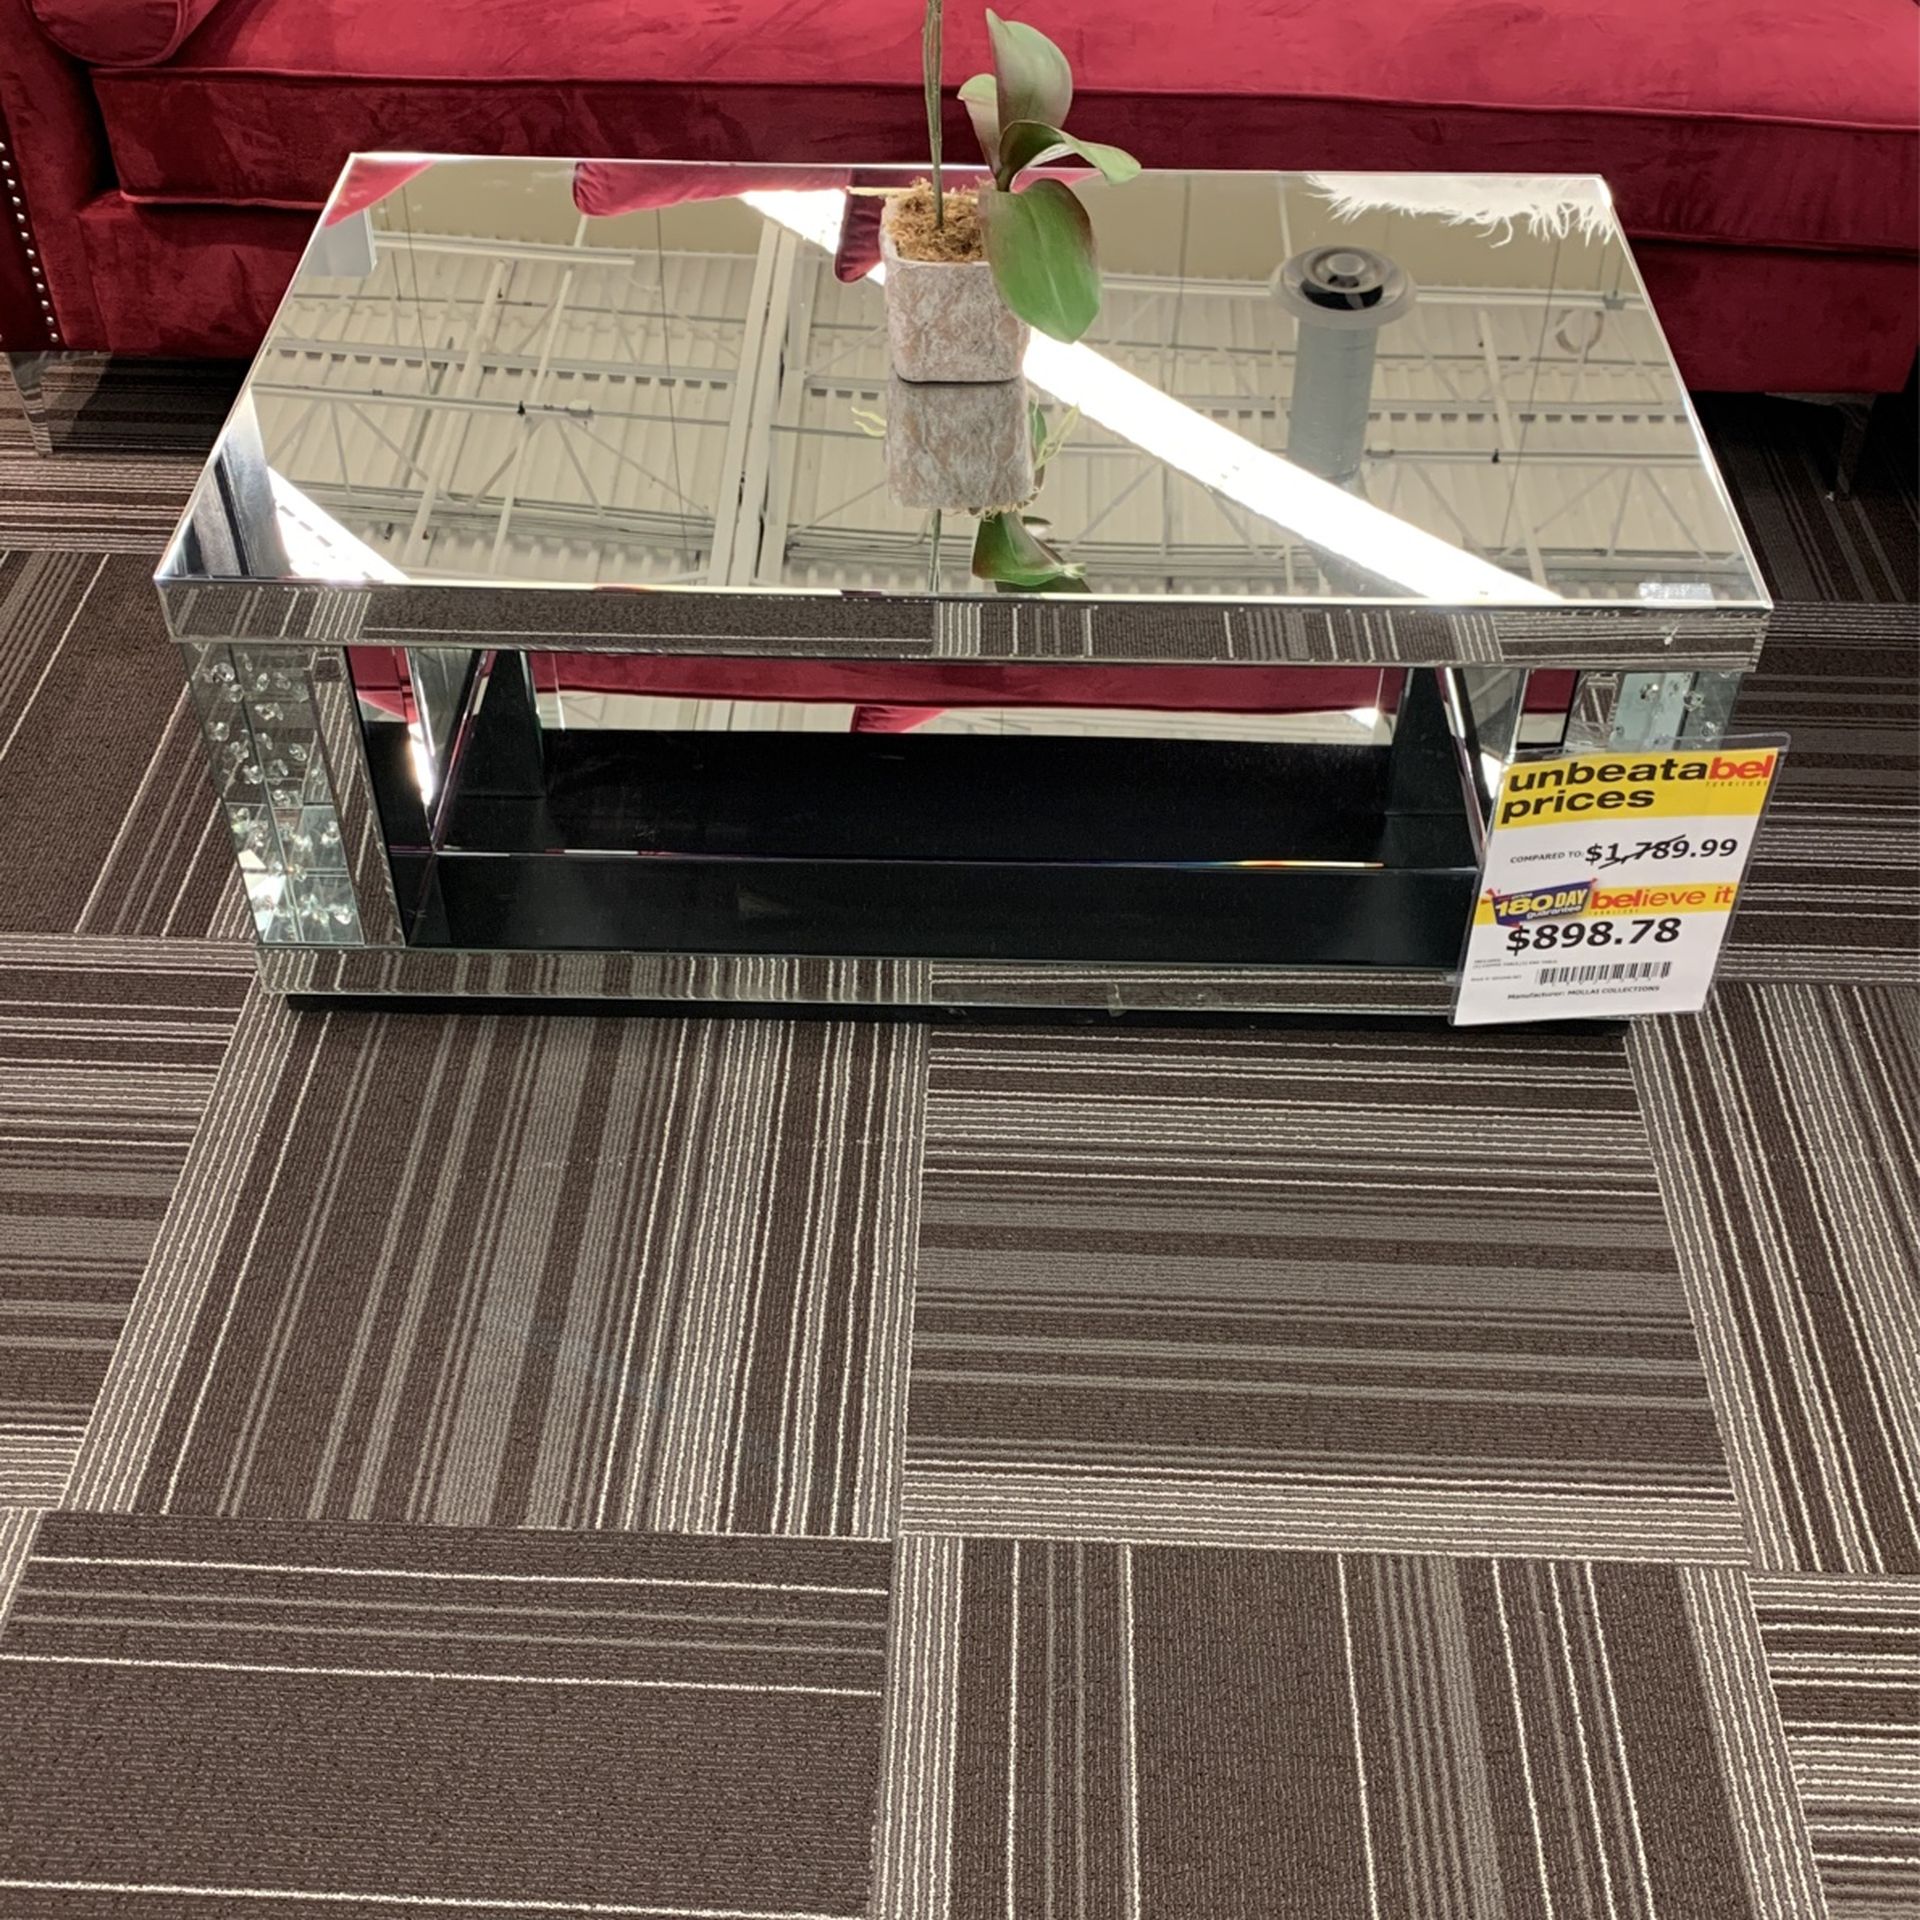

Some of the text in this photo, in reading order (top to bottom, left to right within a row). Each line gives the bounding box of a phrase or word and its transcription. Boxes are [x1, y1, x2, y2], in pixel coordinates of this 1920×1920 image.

[1509, 755, 1773, 792] unbeatabel
[1501, 790, 1655, 823] prices
[1510, 852, 1566, 864] COMPARED
[1585, 834, 1738, 869] $1,789.99
[1495, 897, 1554, 917] 180
[1555, 889, 1589, 907] DAY
[1591, 886, 1733, 909] believe it
[1506, 917, 1681, 955] $898.78
[1507, 991, 1565, 999] Manufacturer:
